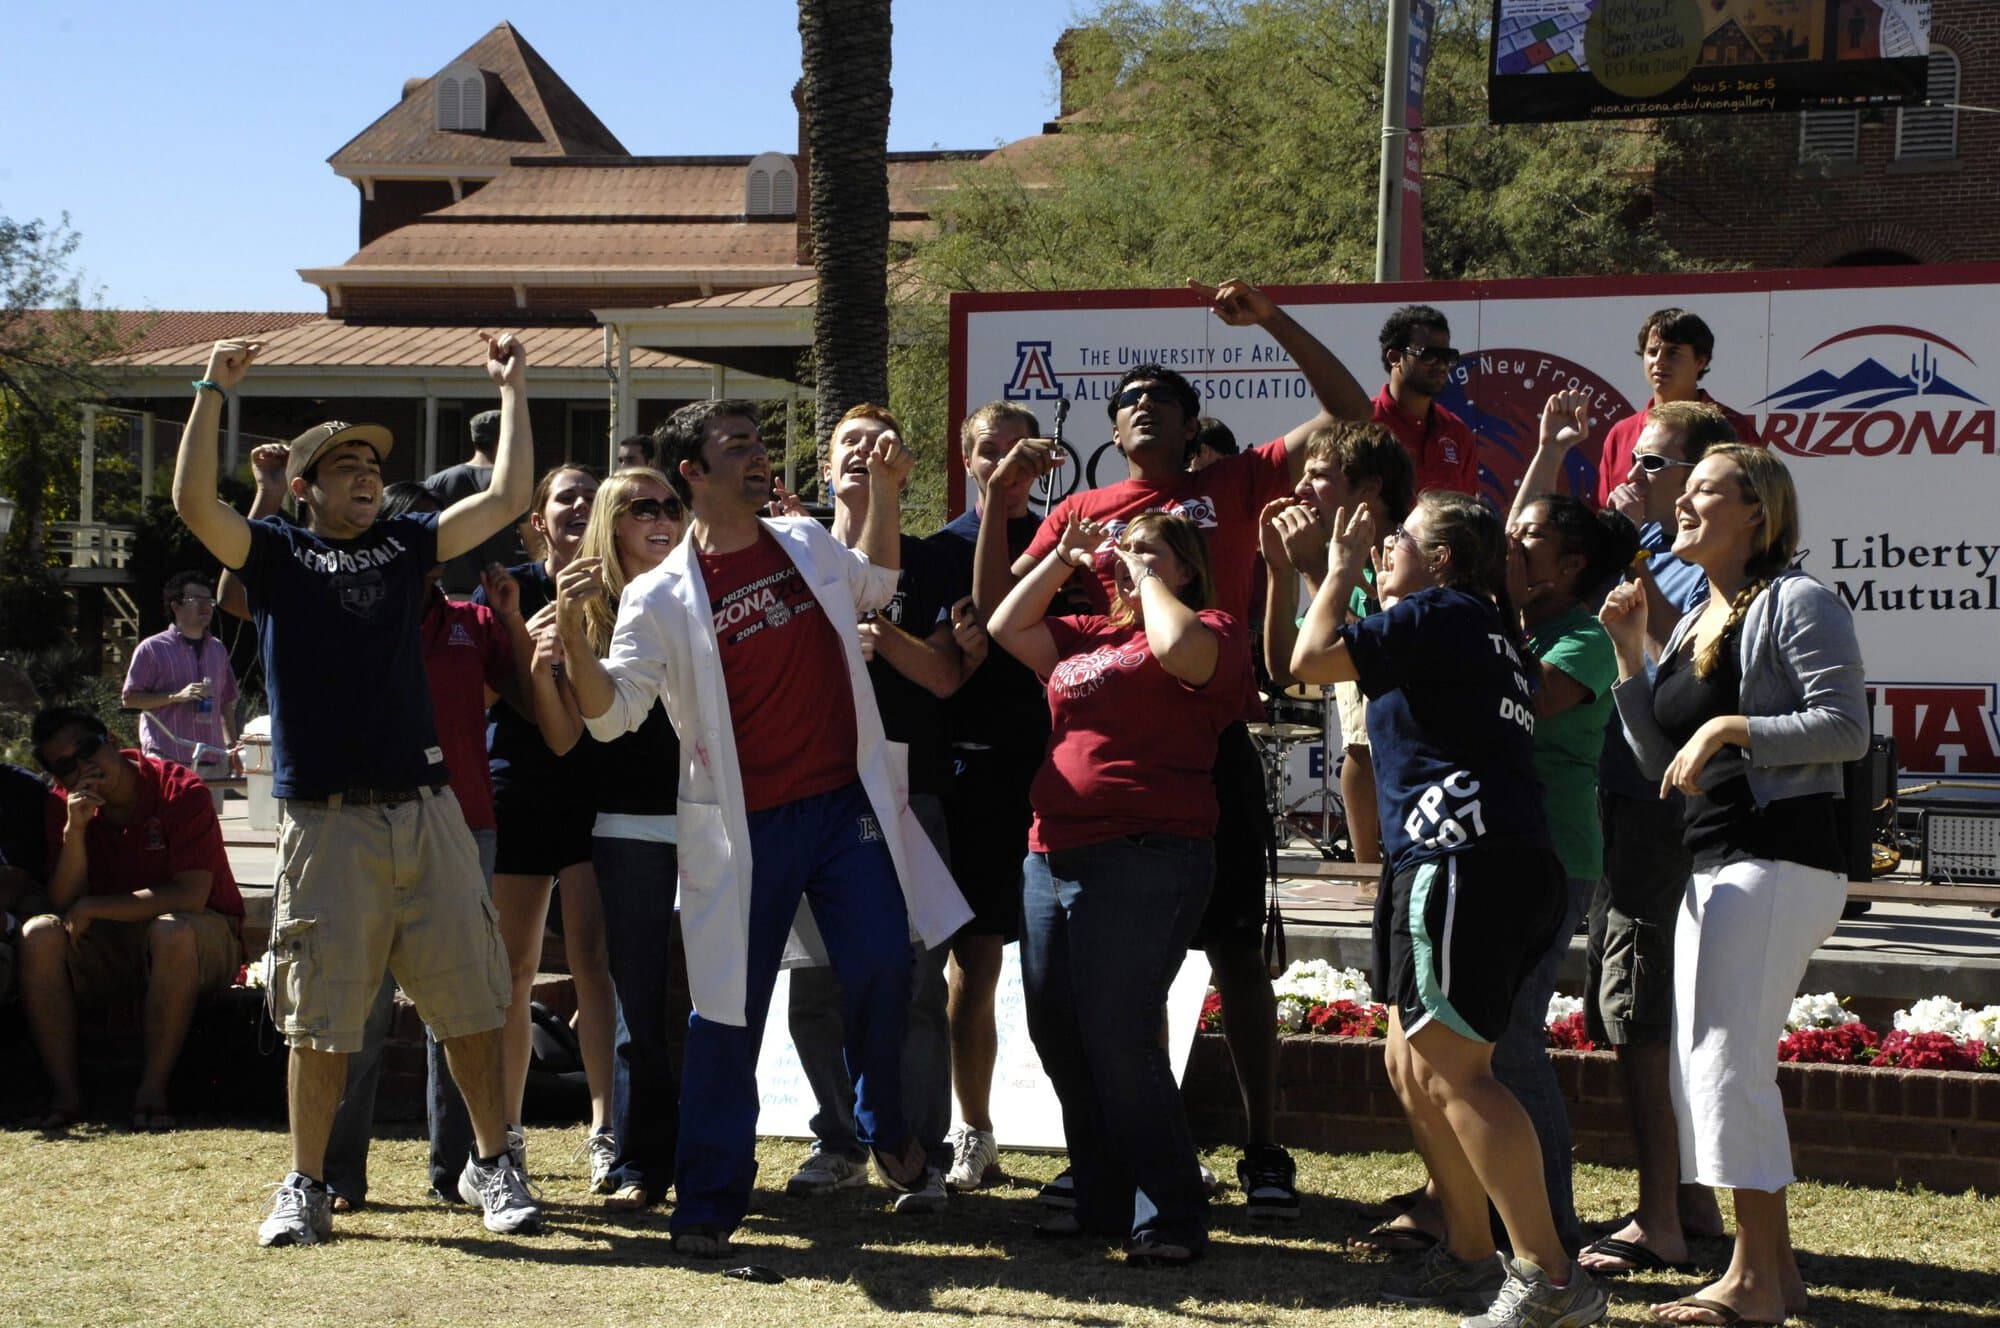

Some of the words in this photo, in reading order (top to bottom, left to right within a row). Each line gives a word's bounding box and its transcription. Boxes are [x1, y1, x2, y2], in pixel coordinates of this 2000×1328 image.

[1737, 80, 1761, 91] Dec
[1764, 78, 1776, 89] 15
[1080, 347, 1111, 366] THE
[1118, 346, 1215, 365] UNIVERSITY
[1222, 347, 1243, 364] OF
[1480, 354, 1526, 376] New
[1192, 377, 1315, 400] SSOCIATIO
[1831, 532, 2000, 578] Liberty
[1833, 574, 2000, 611] Mutual
[735, 620, 764, 643] 2004
[1054, 673, 1105, 700] WILDCATS
[1499, 695, 1535, 737] DOCT
[1403, 769, 1481, 843] FPC
